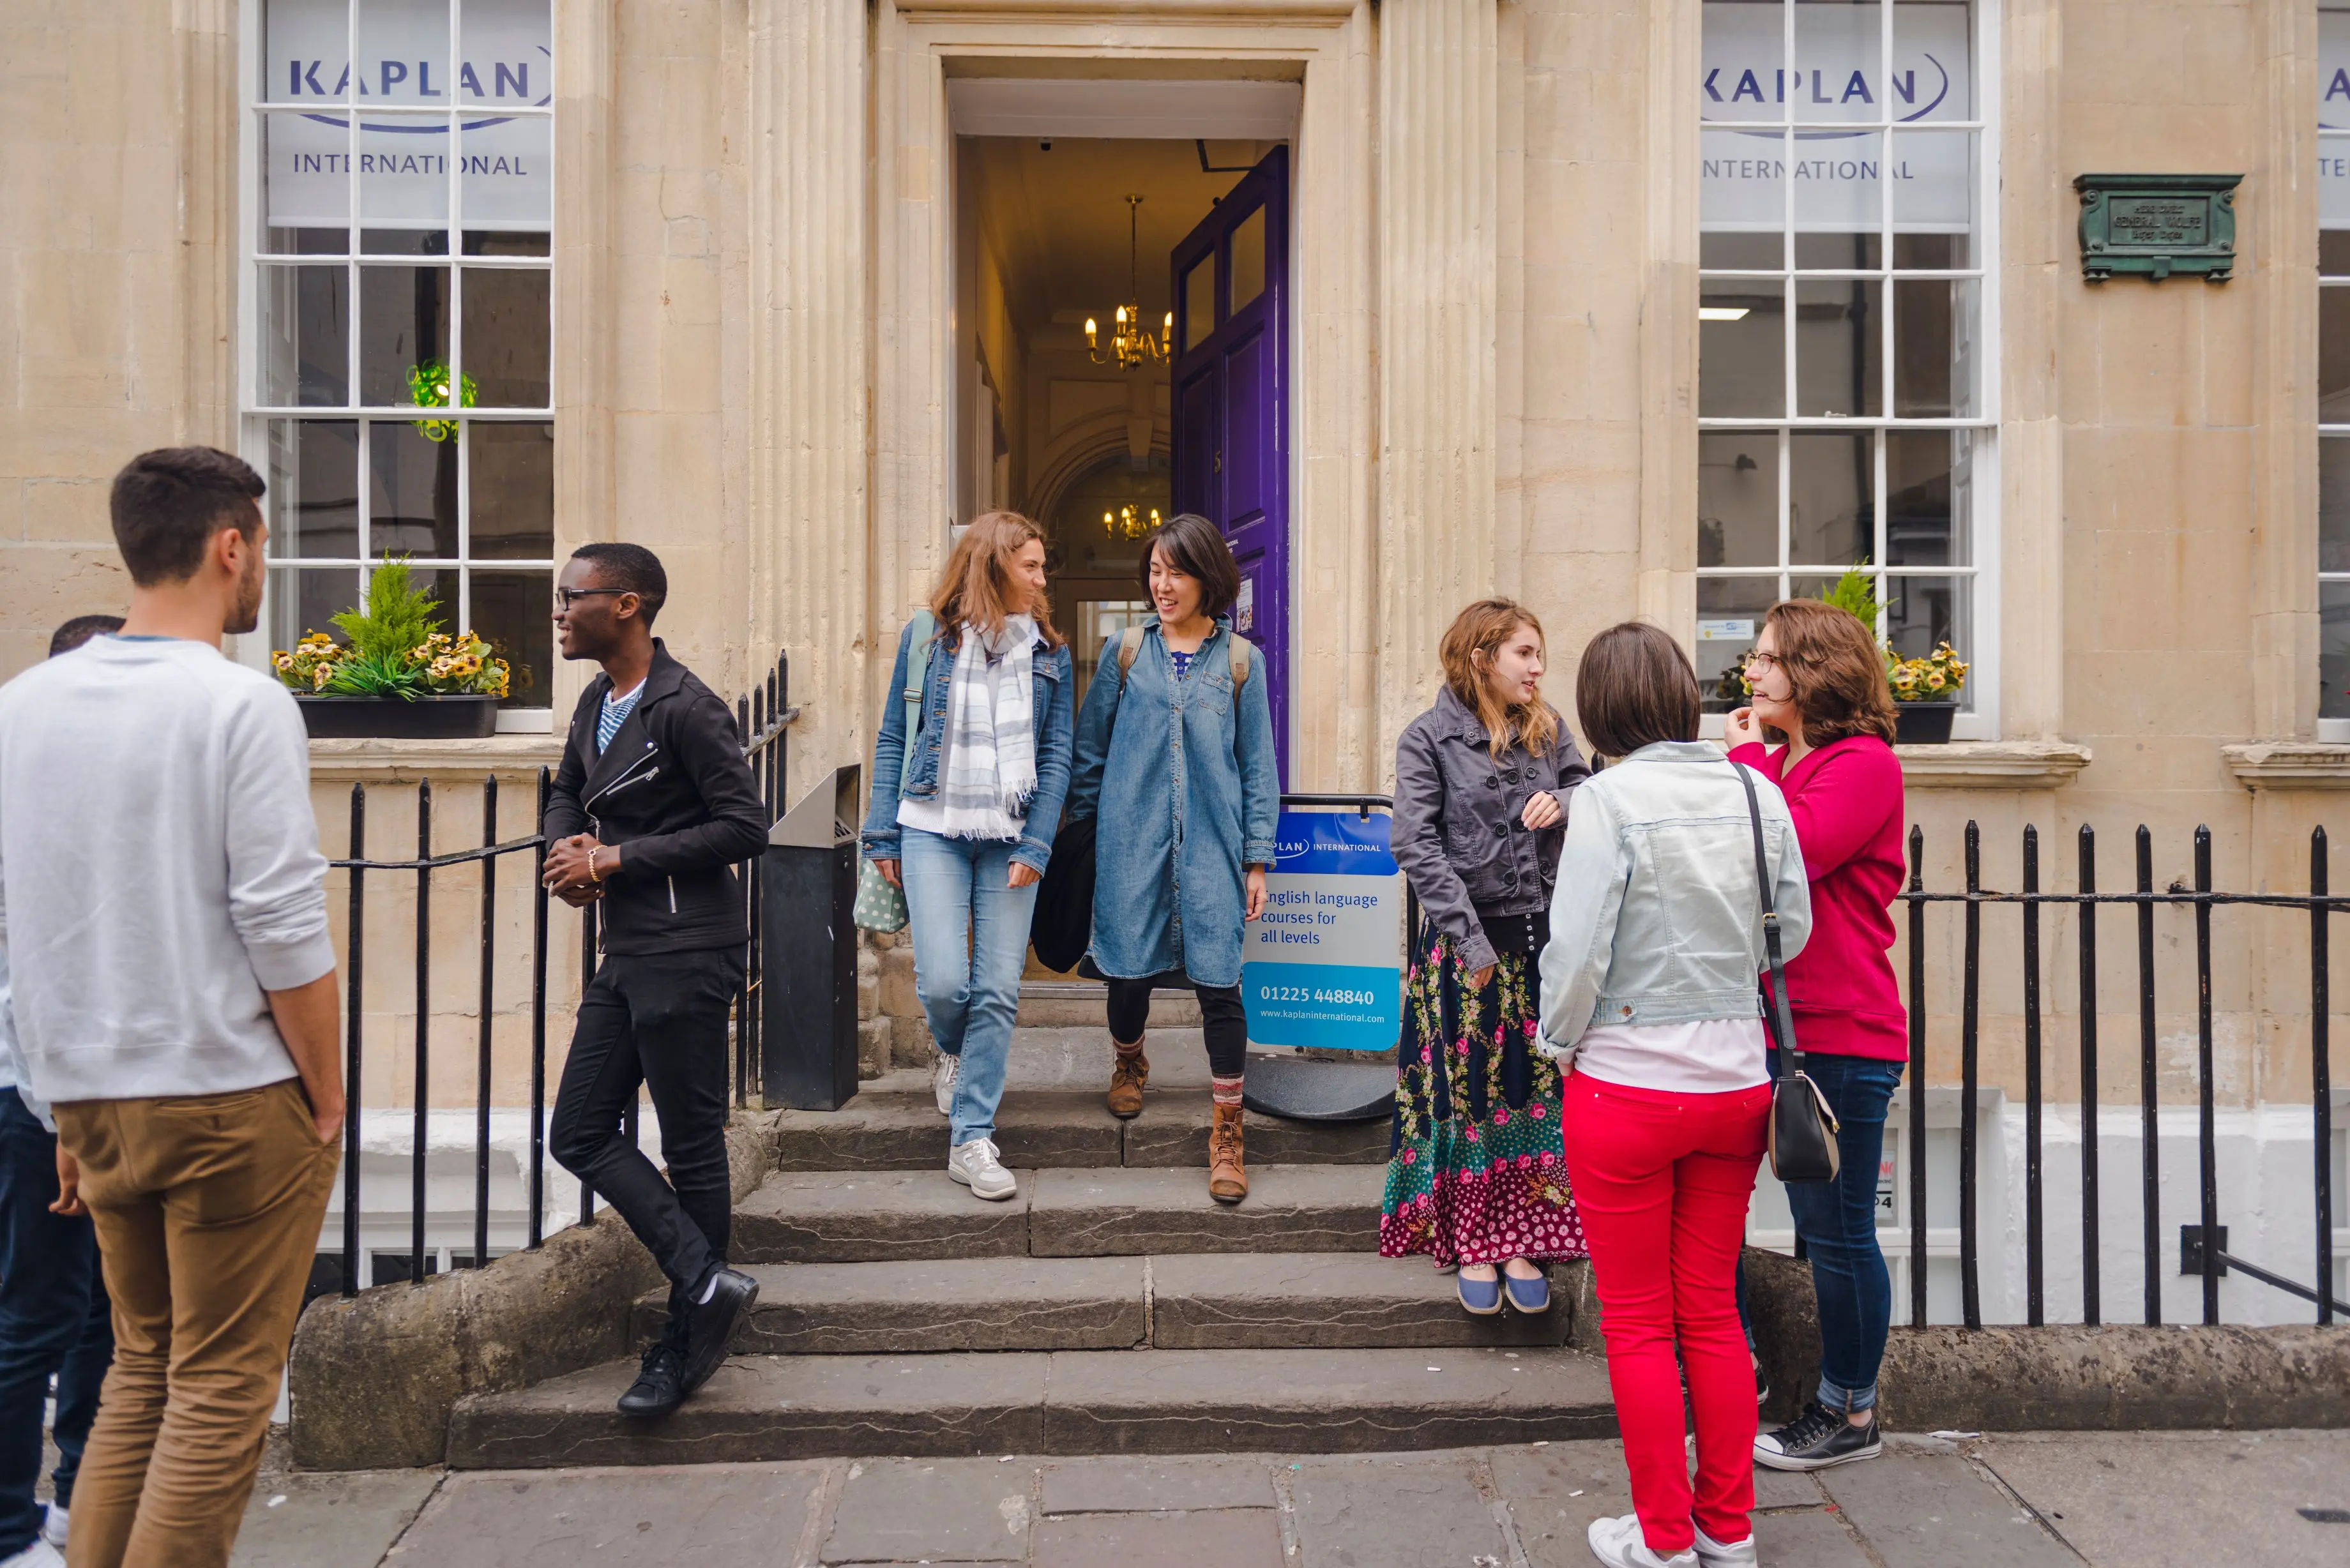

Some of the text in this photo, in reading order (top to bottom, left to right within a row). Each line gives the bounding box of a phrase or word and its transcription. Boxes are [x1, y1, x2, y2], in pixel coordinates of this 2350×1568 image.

[291, 60, 527, 98] KAPLAN
[1703, 160, 1913, 179] NTERNATIONL
[1273, 842, 1381, 852] LAN INTERNATIONAL
[1266, 890, 1377, 908] nglish language
[1261, 912, 1336, 924] courses for
[1261, 930, 1320, 944] all levels
[1261, 986, 1374, 1005] 01225 448840
[1260, 1009, 1384, 1023] www.kaplaninternational.com
